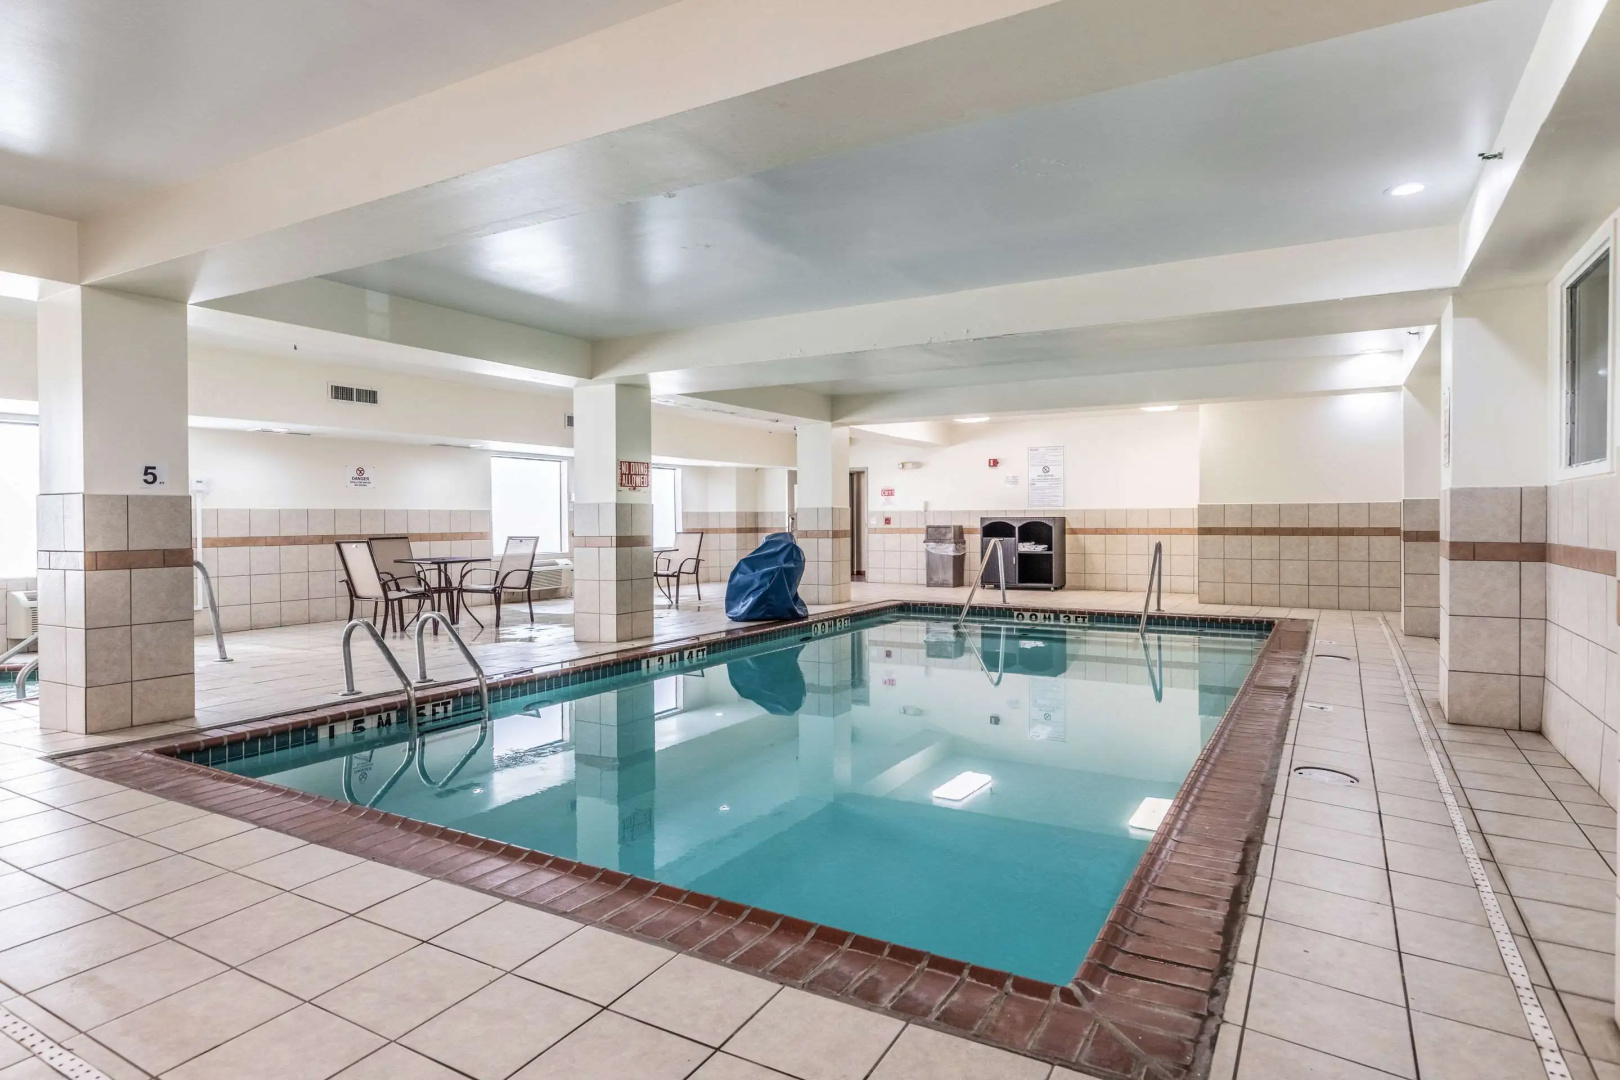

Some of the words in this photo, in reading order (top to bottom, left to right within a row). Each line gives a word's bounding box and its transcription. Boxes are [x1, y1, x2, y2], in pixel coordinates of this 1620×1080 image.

[621, 462, 629, 474] NO
[630, 462, 648, 475] DIVING
[142, 466, 158, 485] 5
[621, 474, 648, 487] ALLOWED
